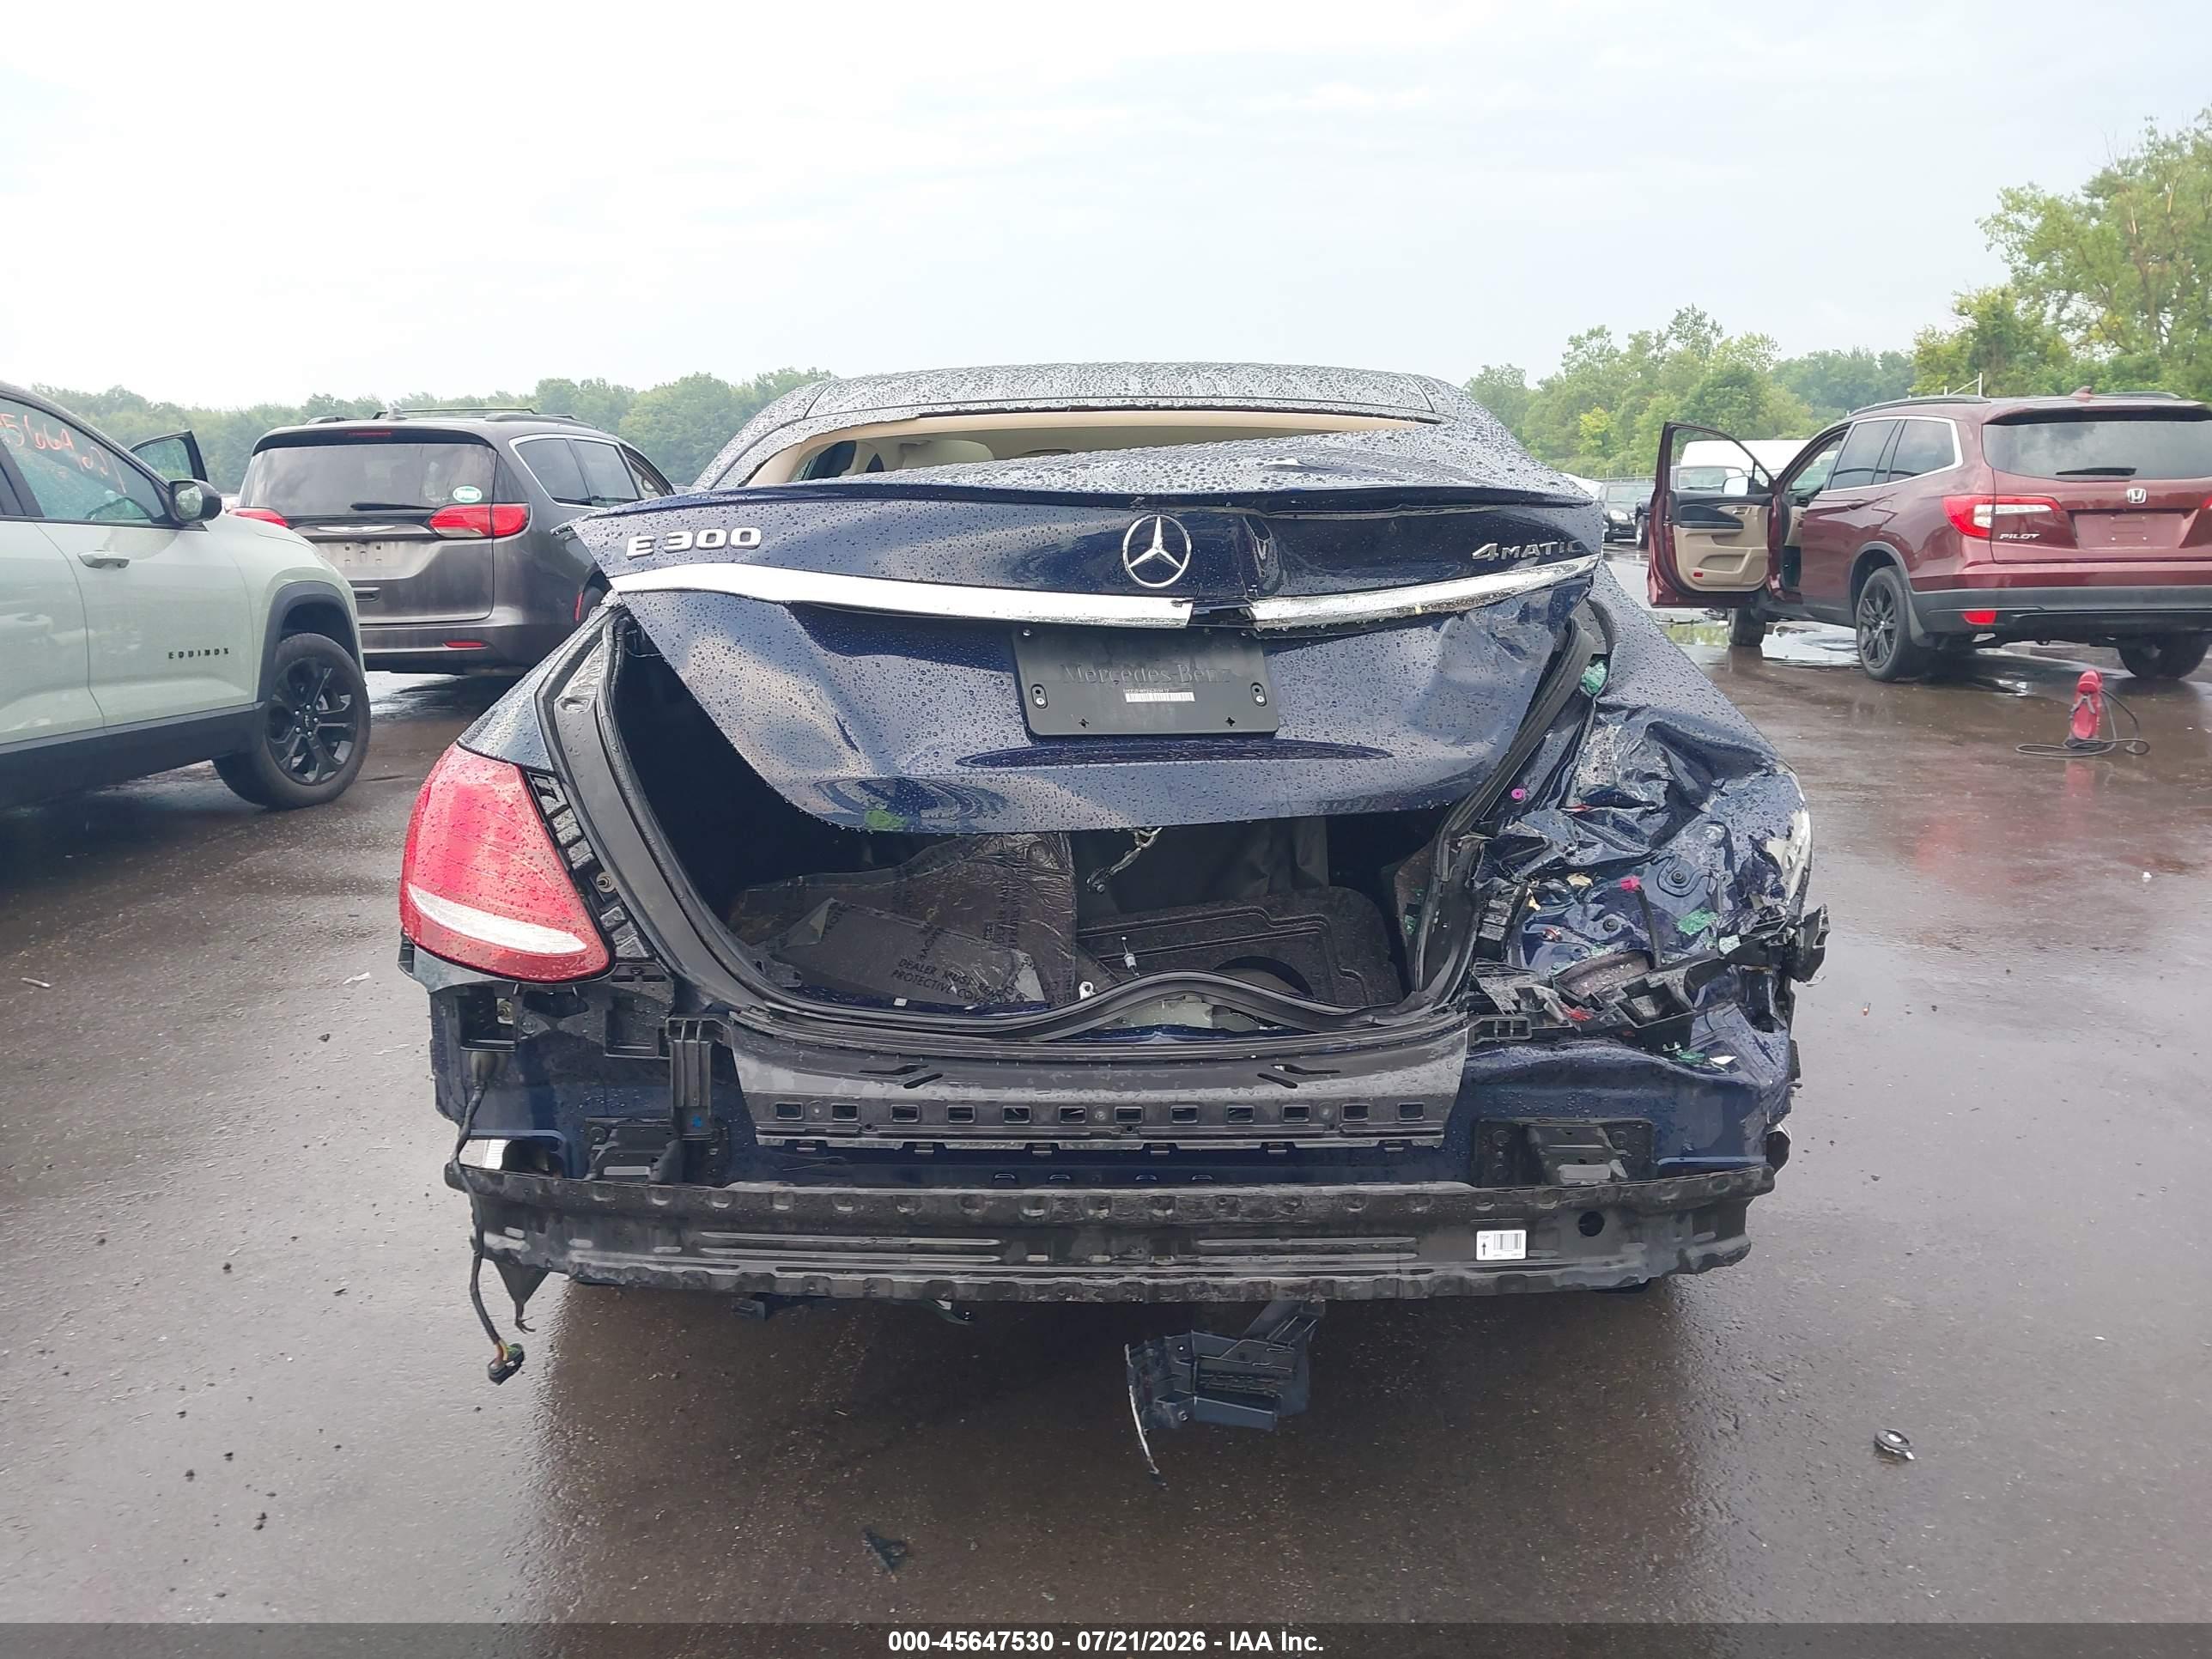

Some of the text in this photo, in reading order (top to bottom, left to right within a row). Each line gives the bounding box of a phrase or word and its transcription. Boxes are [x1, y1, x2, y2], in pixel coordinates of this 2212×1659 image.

[625, 527, 763, 560] E 300
[1471, 539, 1583, 562] 4MATIC
[168, 647, 229, 659] EQUINOX
[898, 958, 938, 975] DEALER
